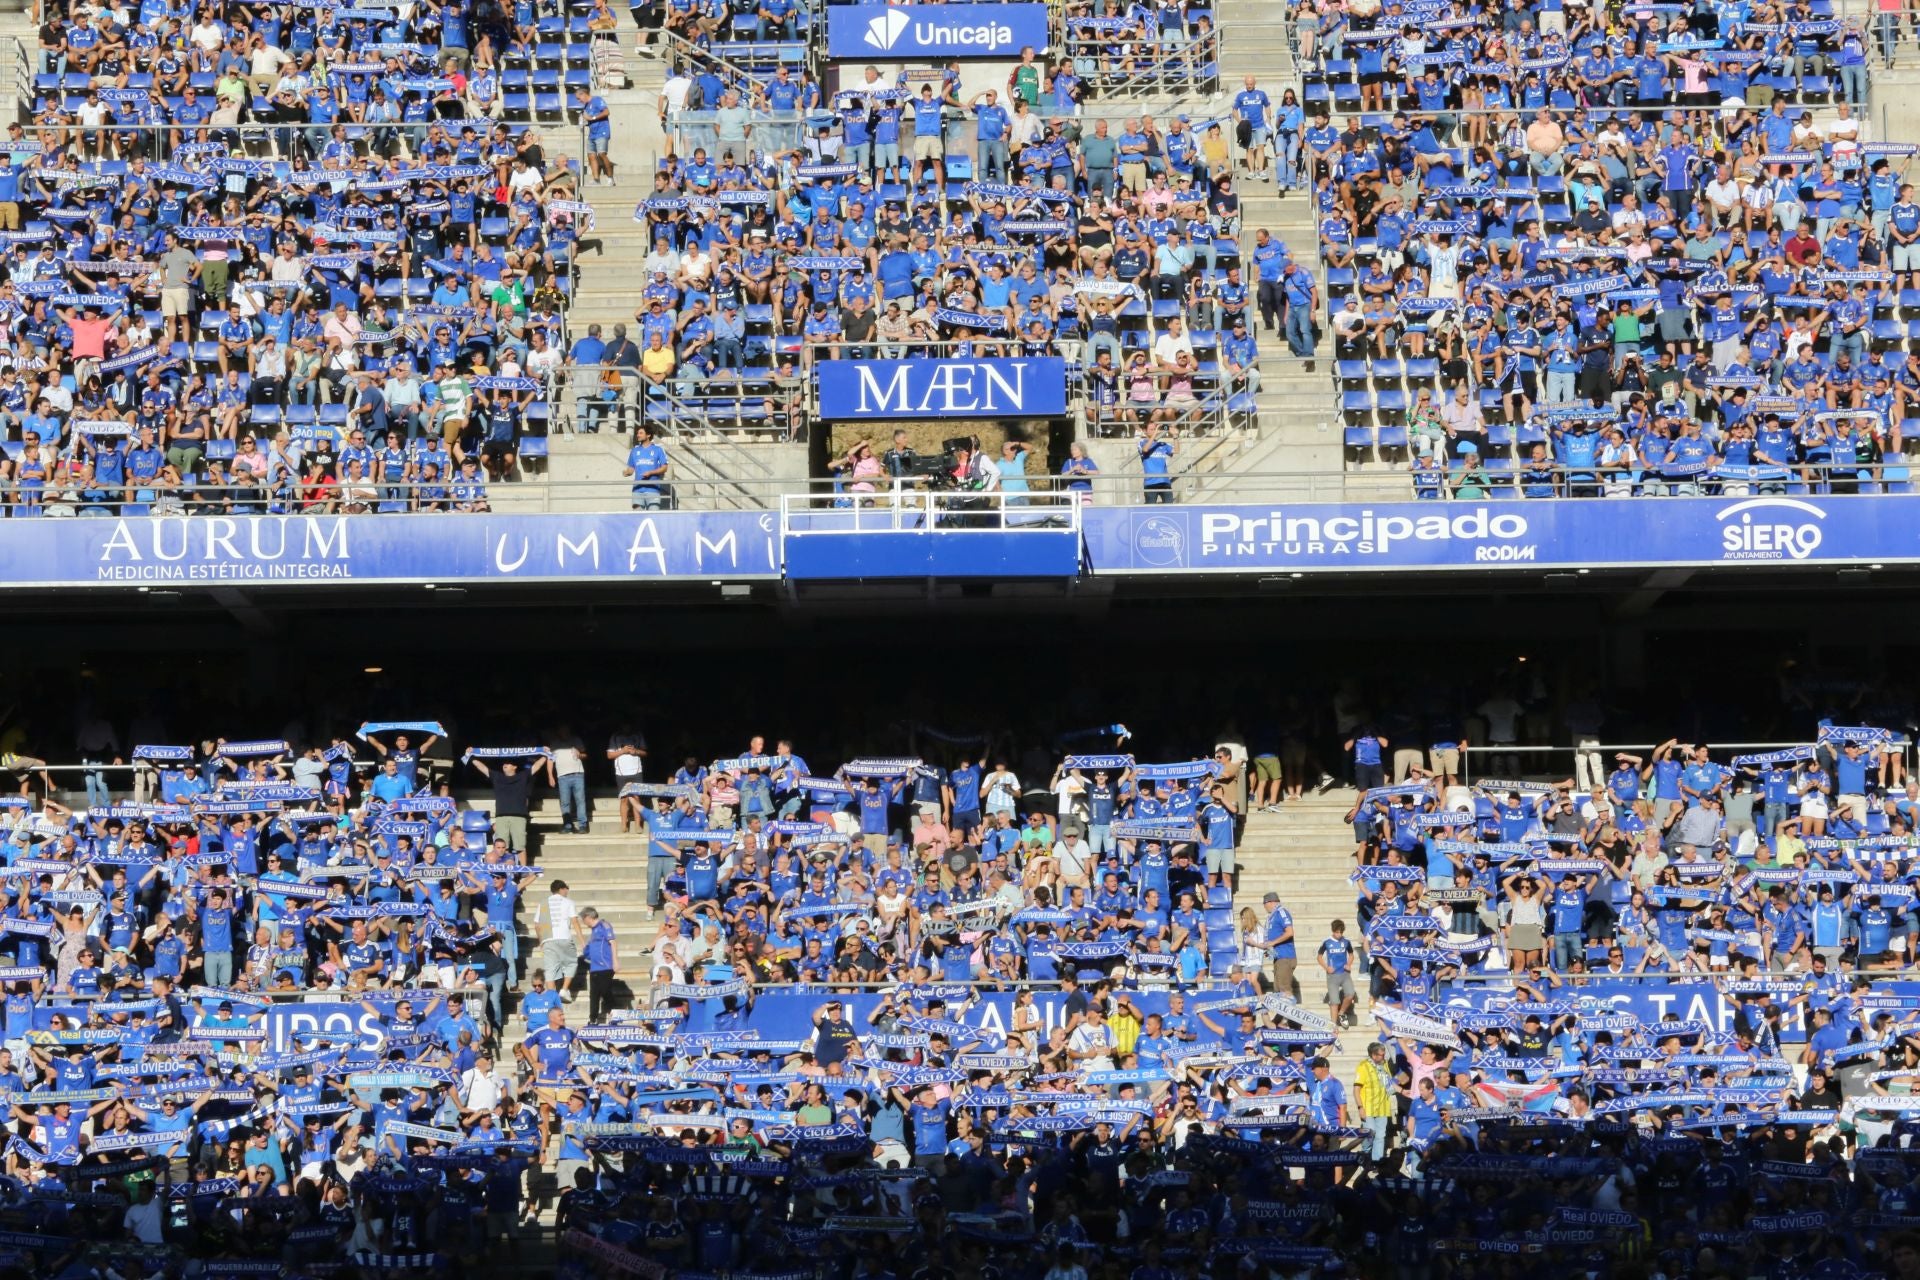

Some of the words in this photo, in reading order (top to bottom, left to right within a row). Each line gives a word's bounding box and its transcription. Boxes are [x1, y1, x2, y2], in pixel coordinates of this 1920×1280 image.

[916, 22, 1012, 50] Unicaja
[290, 172, 311, 181] Real
[313, 170, 346, 181] OVIEDO
[736, 191, 767, 201] OVIEDO
[1846, 271, 1879, 279] OVIEDO
[1563, 285, 1580, 295] Real
[1582, 279, 1617, 293] OVIEDO
[1694, 284, 1717, 293] Real
[1719, 283, 1759, 292] Oviedo
[59, 295, 78, 304] Real
[81, 295, 115, 305] OVIEDO
[101, 346, 157, 372] INQUEBRANTABLE
[855, 363, 1028, 412] MÆN
[1735, 468, 1748, 476] AZUL
[1202, 508, 1528, 552] Principado
[103, 517, 350, 561] AURUM
[1202, 541, 1375, 556] PINTURAS
[1476, 545, 1536, 561] RODIM
[1724, 551, 1782, 559] AYUNTAMIENTO
[98, 566, 184, 580] MEDICINA
[190, 563, 265, 579] ESTÉTICA
[269, 563, 352, 578] INTEGRAL
[501, 746, 537, 755] OVIEDO
[723, 759, 747, 769] SOLO
[751, 758, 770, 767] POR
[1152, 767, 1167, 775] Real
[1168, 765, 1190, 774] OVIEDO
[210, 804, 223, 812] Real
[225, 803, 249, 811] OVIEDO
[418, 801, 449, 810] OVIEDO
[90, 808, 110, 817] REAL
[111, 807, 141, 817] OVIEDO
[1421, 815, 1439, 824] Real
[1440, 813, 1473, 824] OVIEDO
[1809, 871, 1824, 879] Real
[913, 987, 932, 999] Real
[935, 986, 967, 997] Oviedo
[1730, 982, 1761, 992] FORZA
[1766, 982, 1802, 992] OVIEDO
[1863, 999, 1877, 1007] Real
[1878, 998, 1902, 1007] OVIEDO
[1581, 1016, 1603, 1030] Real
[83, 1029, 120, 1039] OVIEDO
[577, 1026, 643, 1039] NQUEBRANTABLES
[1263, 1032, 1332, 1042] INQUEBRANTABLE
[888, 1035, 927, 1045] OVIEDO
[962, 1056, 978, 1066] Real
[980, 1057, 1006, 1067] OVIEDO
[117, 1064, 138, 1074] Real
[140, 1062, 179, 1072] OVIEDO
[1107, 1071, 1134, 1079] SOLO
[1729, 1077, 1751, 1087] EJATE
[1058, 1101, 1082, 1111] STO
[1715, 1114, 1748, 1123] OVIEDO
[139, 1131, 181, 1145] OVIEDO
[1562, 1210, 1587, 1222] Real
[1590, 1211, 1632, 1225] OVIEDO
[1753, 1217, 1777, 1230] Real
[1780, 1215, 1823, 1230] OVIEDO
[1552, 1229, 1594, 1242] OVIEDO
[1480, 1241, 1519, 1254] OVIEDO
